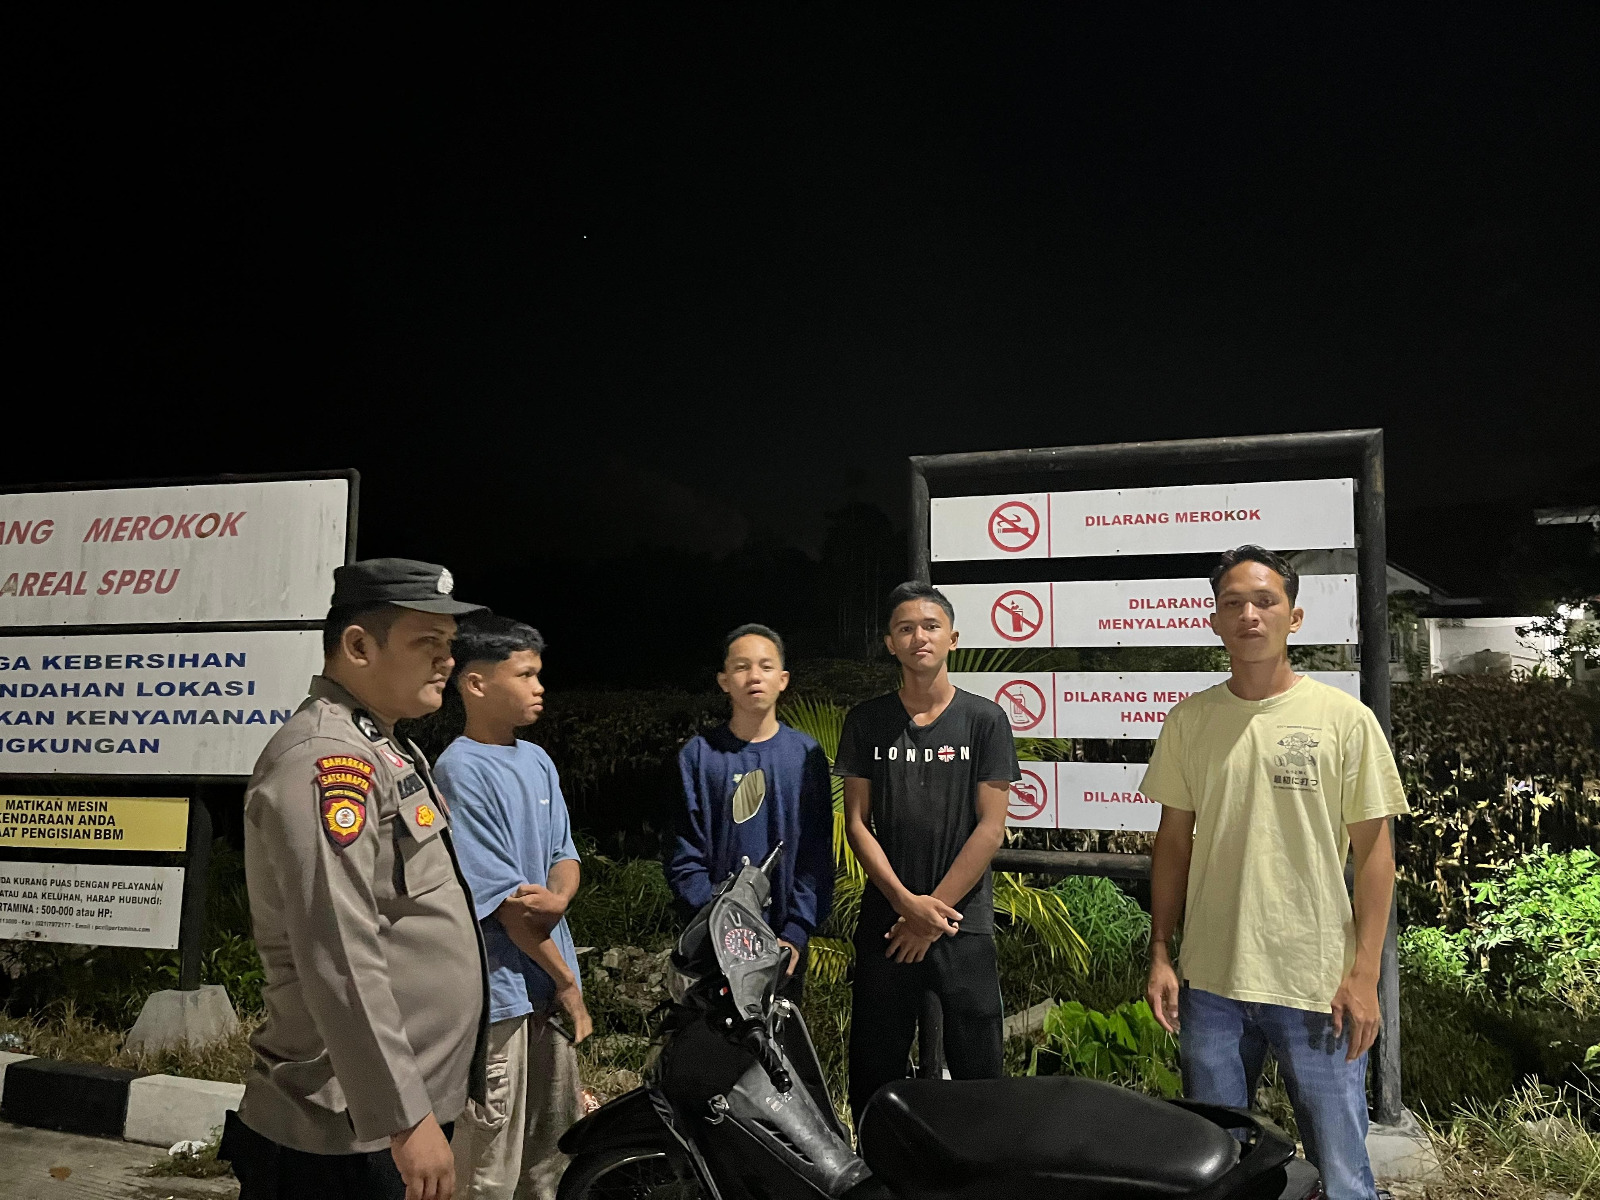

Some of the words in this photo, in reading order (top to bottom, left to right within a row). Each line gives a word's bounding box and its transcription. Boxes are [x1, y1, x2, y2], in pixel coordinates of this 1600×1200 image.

[1085, 512, 1170, 527] DILARANG
[1175, 509, 1262, 523] MEROKOK
[0, 519, 54, 545] NG
[82, 511, 247, 542] MEROKOK
[0, 571, 88, 597] AREAL
[96, 568, 181, 595] SPBU
[1129, 597, 1215, 610] DILARANG
[42, 652, 247, 670] KEBERSIHAN
[136, 680, 256, 697] LOKASI
[1063, 691, 1148, 703] DILARANG
[66, 709, 292, 725] KENYAMANAN
[0, 738, 160, 754] GKUNGAN
[5, 799, 63, 812] MATIKAN
[66, 800, 108, 812] MESIN
[0, 812, 74, 826] ENDARAAN
[77, 815, 116, 826] ANDA
[0, 827, 17, 838] AT
[21, 827, 91, 840] PENGISIAN
[94, 828, 124, 840] BBM
[0, 876, 11, 885] DA
[13, 877, 48, 886] KURANG
[50, 879, 72, 888] PUAS
[74, 880, 110, 889] DENGAN
[112, 881, 164, 891] PELAYANAN
[0, 889, 19, 898] ATAU
[22, 891, 38, 899] ADA
[41, 892, 83, 903] KELUHAN,
[86, 894, 116, 903] HARAP
[118, 895, 163, 906] HUBUNGI:
[41, 905, 74, 916] 500-000
[76, 907, 95, 917] atau
[97, 908, 113, 918] HP:
